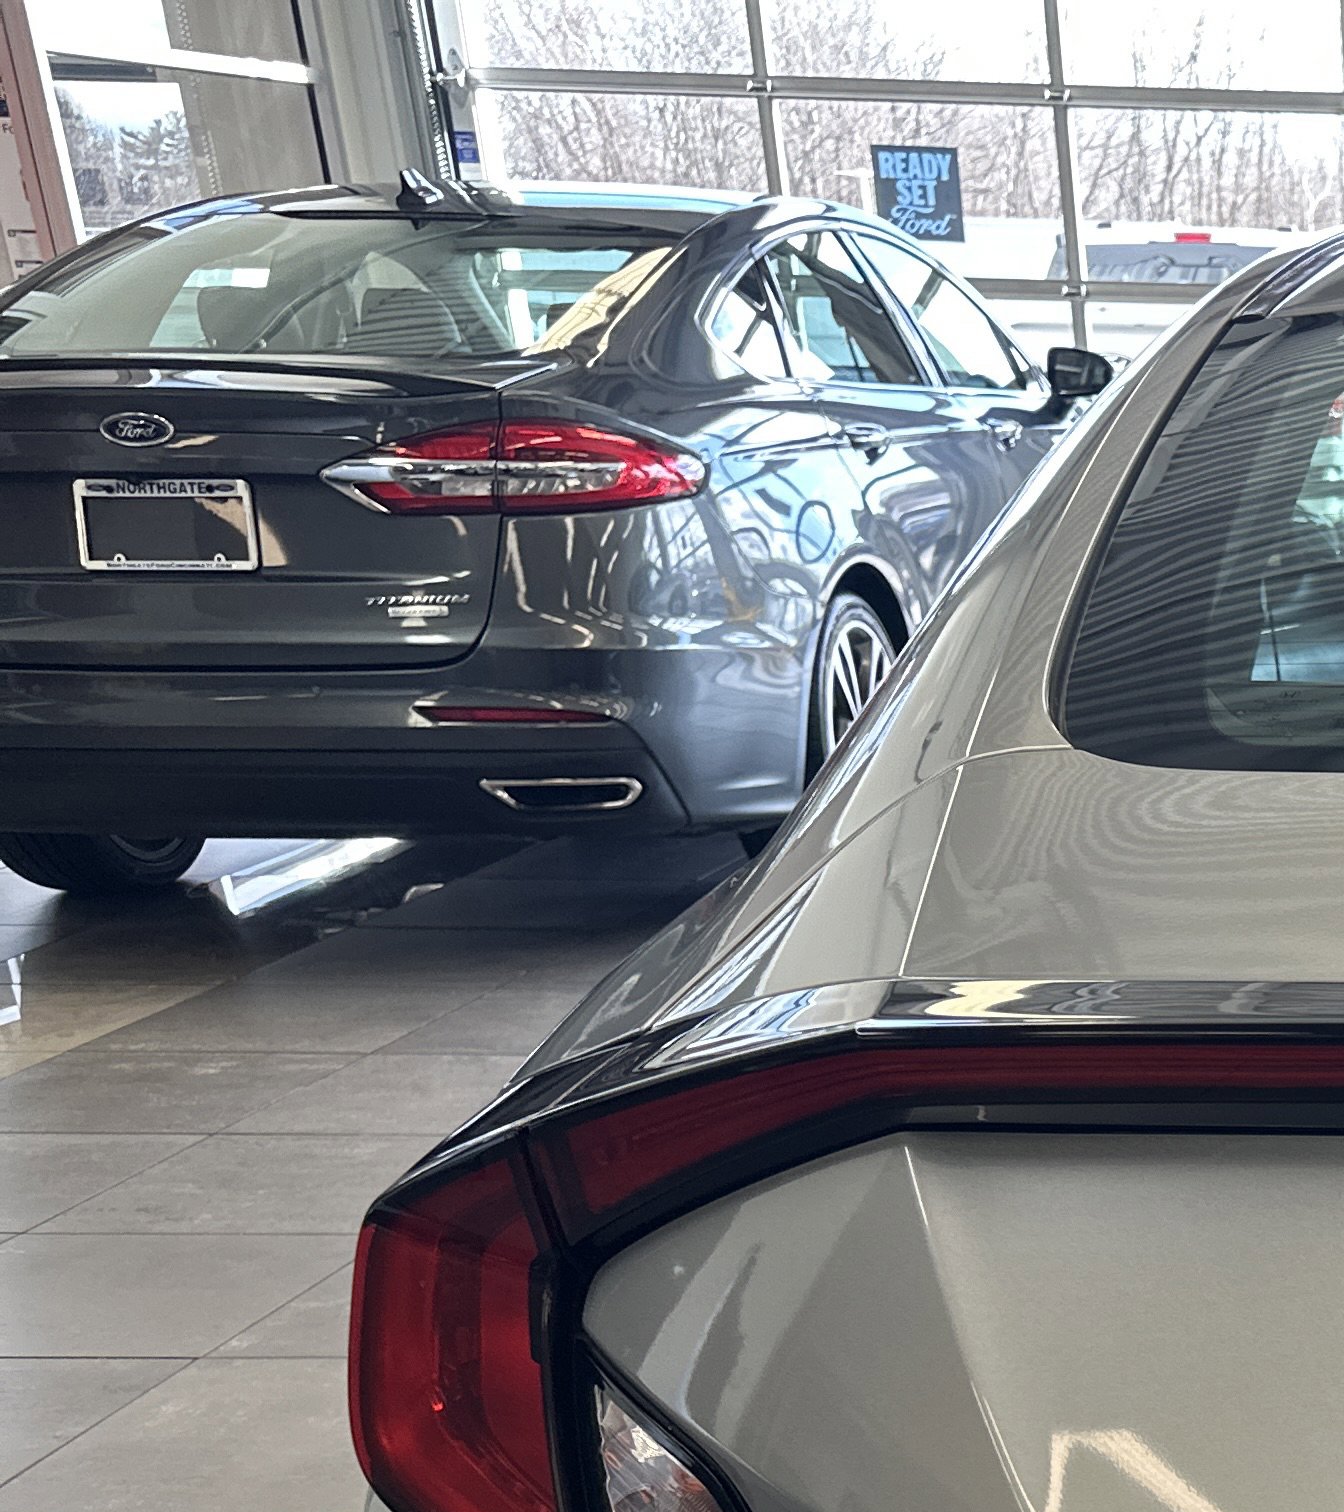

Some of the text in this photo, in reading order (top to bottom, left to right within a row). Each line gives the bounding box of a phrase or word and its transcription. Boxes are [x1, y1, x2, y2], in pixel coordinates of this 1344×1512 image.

[878, 151, 951, 181] READY
[896, 179, 937, 206] SET
[889, 205, 957, 235] Ford
[115, 420, 156, 438] Ford
[116, 481, 206, 494] NORTHGATE
